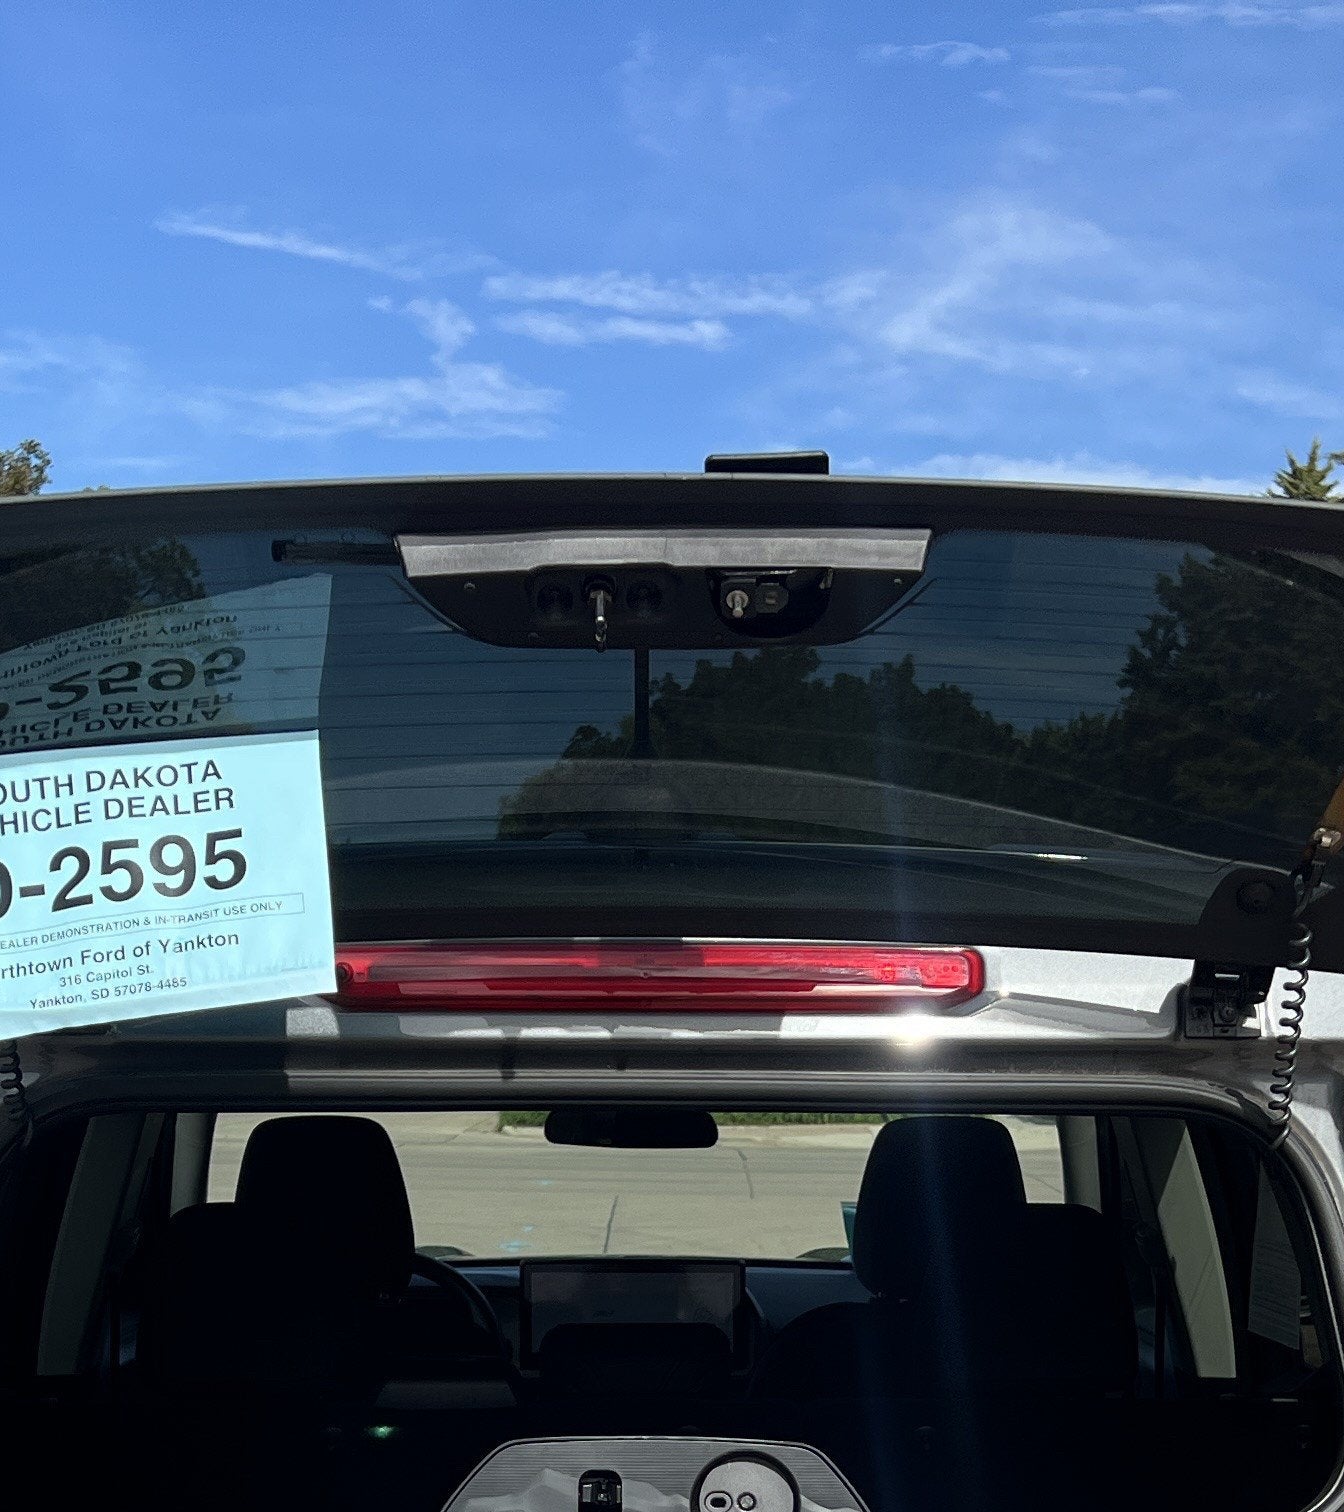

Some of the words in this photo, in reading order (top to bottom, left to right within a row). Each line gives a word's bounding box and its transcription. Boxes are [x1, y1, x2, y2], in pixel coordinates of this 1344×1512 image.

[85, 759, 222, 793] DAKOTA
[104, 787, 235, 821] DEALER
[41, 918, 140, 944] DEMONSTRATION
[143, 917, 150, 925] &
[155, 909, 219, 925] IN-TRANSIT
[224, 904, 246, 916] USE
[250, 900, 283, 914] ONLY
[80, 945, 125, 965] Ford
[133, 941, 151, 958] of
[158, 933, 239, 954] Yankton
[60, 974, 81, 987] 316
[86, 965, 132, 983] Capitol
[137, 964, 154, 976] St.
[91, 988, 109, 1000] SD
[114, 976, 187, 997] 57078-4485
